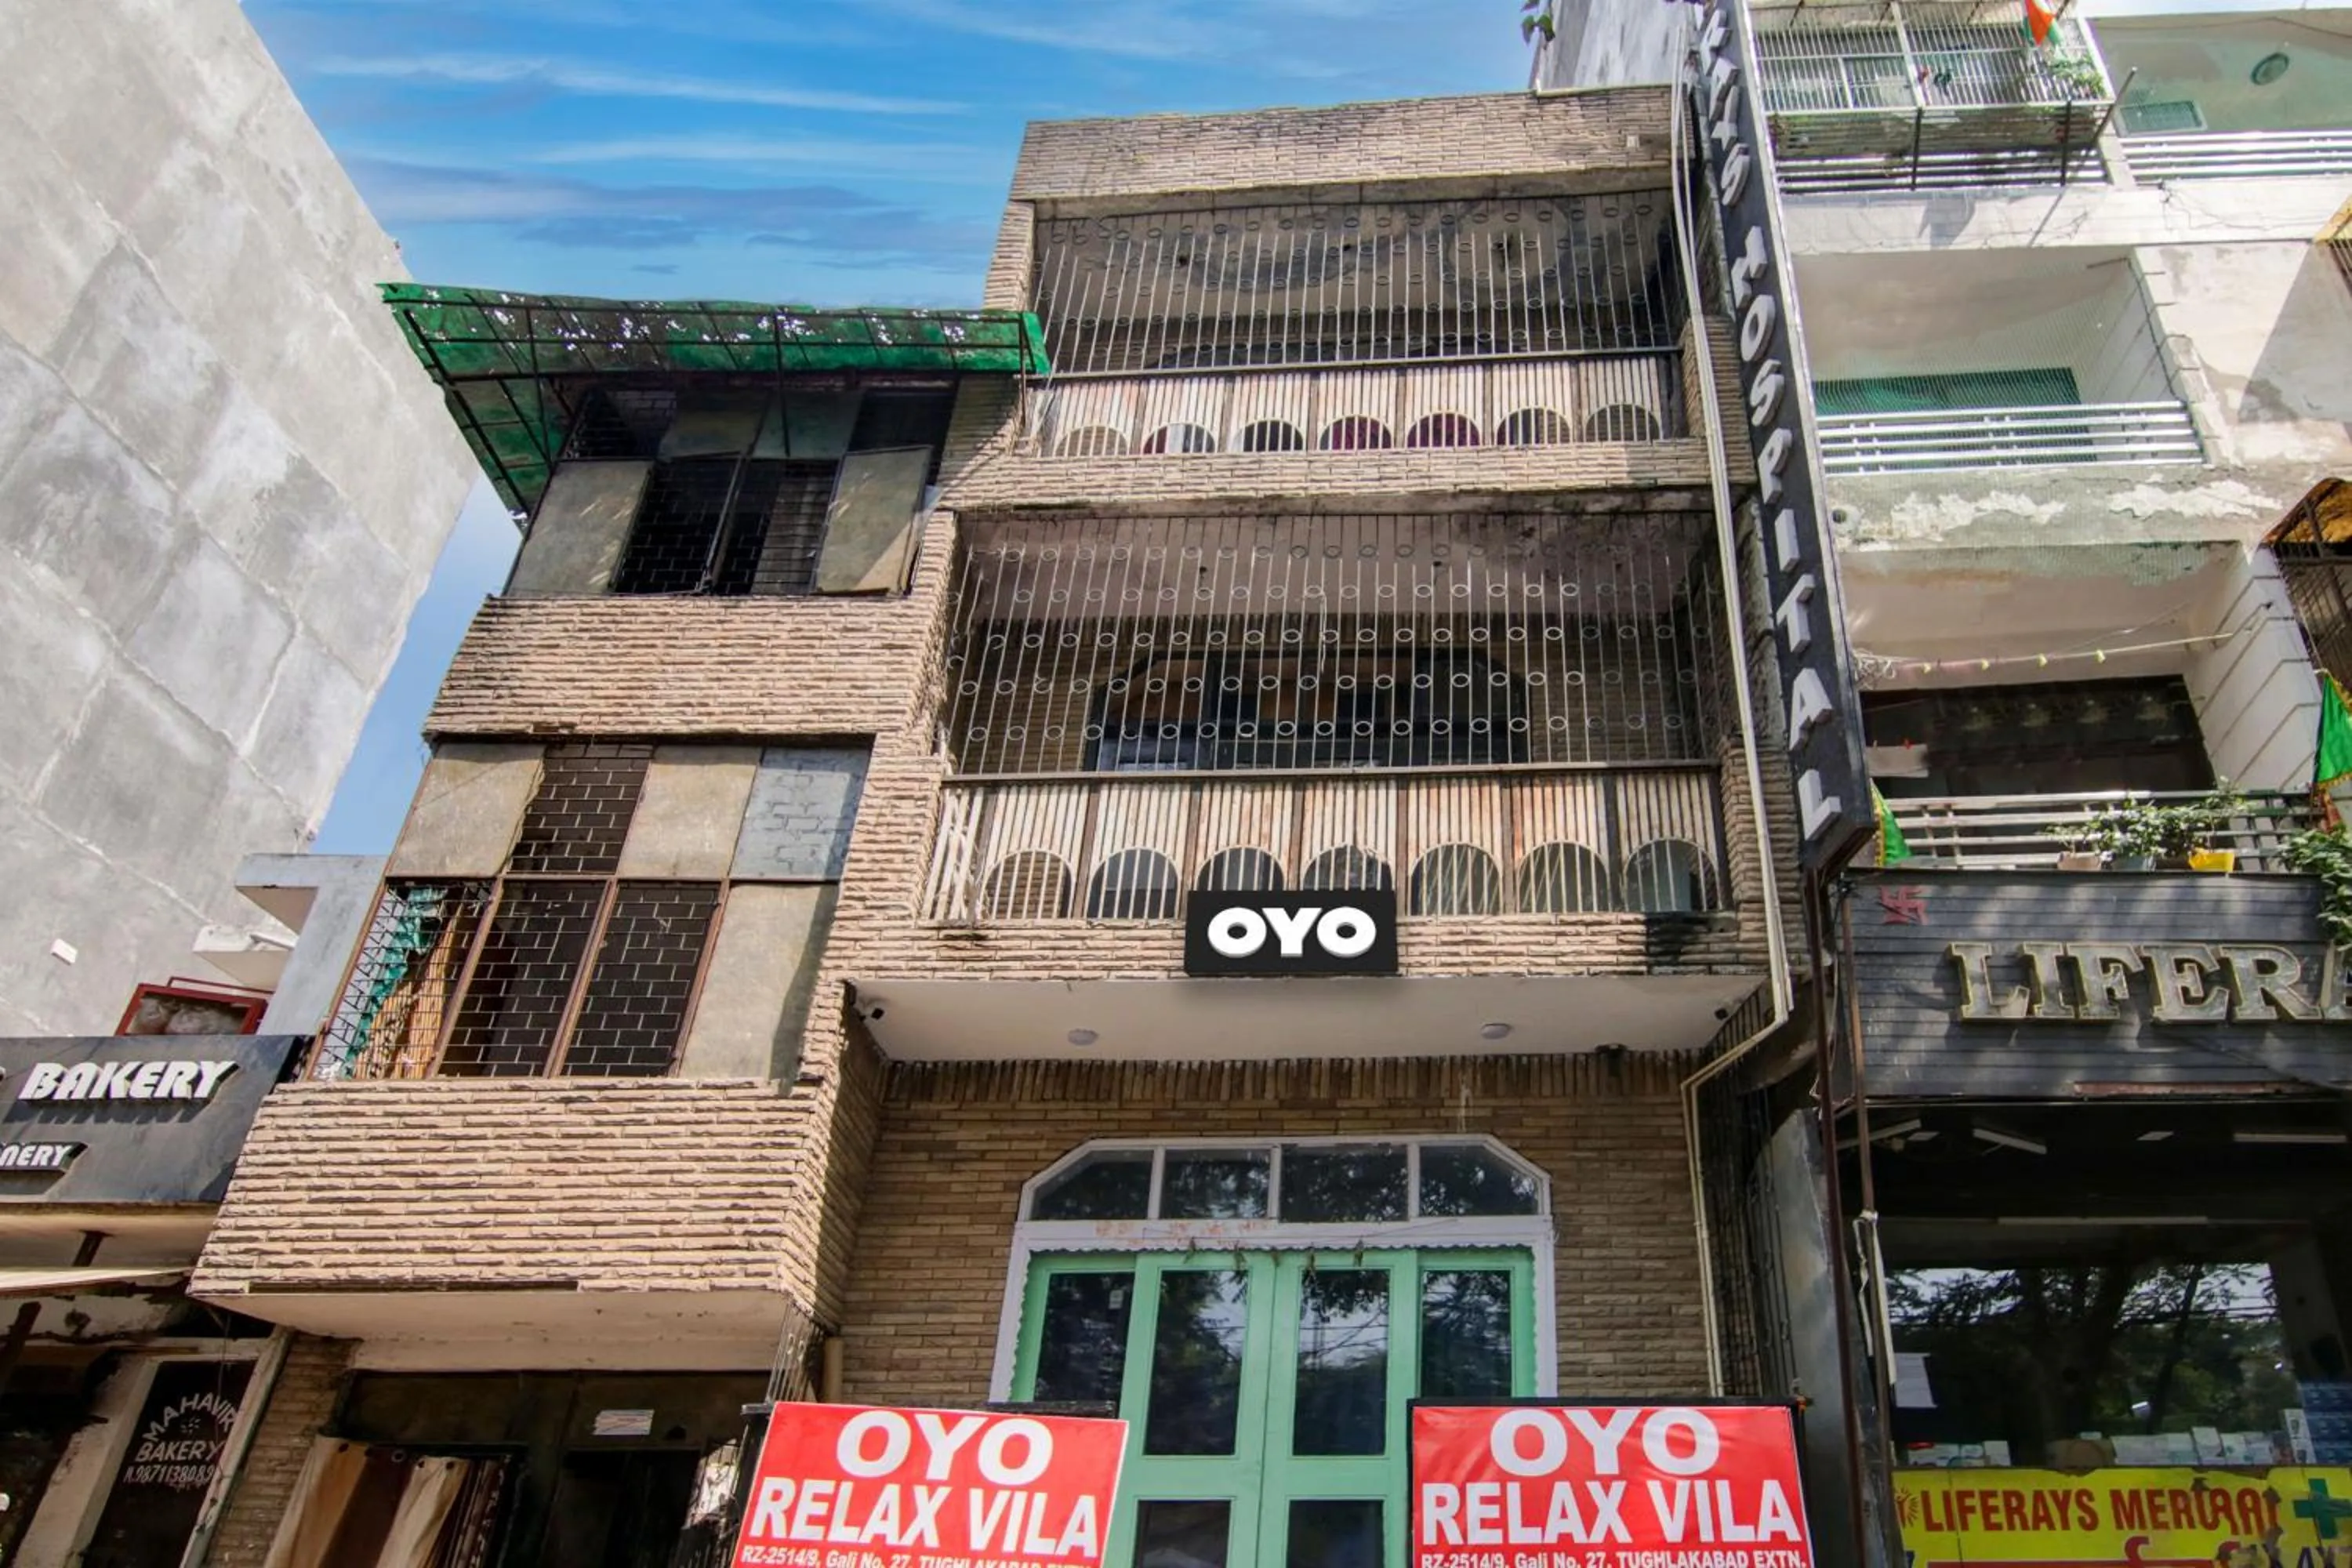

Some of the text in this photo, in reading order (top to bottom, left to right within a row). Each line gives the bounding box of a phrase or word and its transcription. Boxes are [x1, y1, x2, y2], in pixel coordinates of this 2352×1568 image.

[1730, 225, 1842, 841] HOSPITAL
[1207, 906, 1377, 958] OYO
[18, 1061, 238, 1100] BAKERY
[142, 1392, 237, 1442] MAHAVIR
[837, 1410, 1054, 1486] OYO
[1490, 1407, 1720, 1477] OYO
[134, 1439, 226, 1462] BAKERY
[749, 1476, 952, 1548] RELAX
[968, 1488, 1098, 1558] VILA
[1422, 1481, 1632, 1544] RELAX
[1646, 1479, 1802, 1543] VILA
[1921, 1488, 2100, 1532] LIFERAYS
[1615, 1551, 1749, 1568] TUGHLAKABAD
[1752, 1551, 1806, 1568] EXTN.
